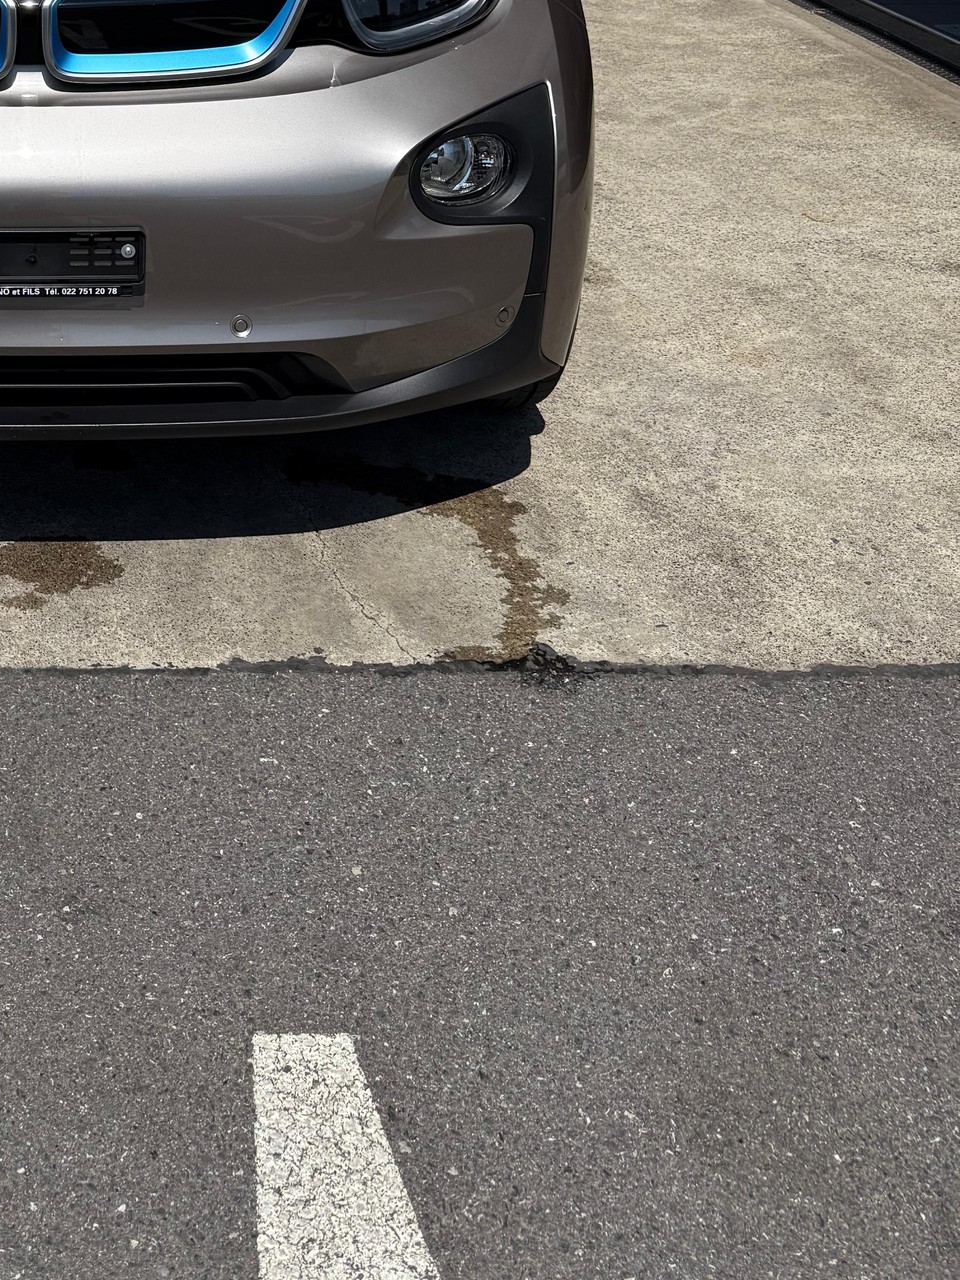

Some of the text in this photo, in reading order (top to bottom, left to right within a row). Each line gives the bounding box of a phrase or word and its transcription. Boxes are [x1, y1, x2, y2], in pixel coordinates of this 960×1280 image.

[11, 288, 21, 296] et
[22, 287, 41, 296] FILS
[61, 287, 76, 295] 022
[78, 287, 93, 295] 751
[95, 287, 105, 295] 20
[107, 287, 118, 295] 78
